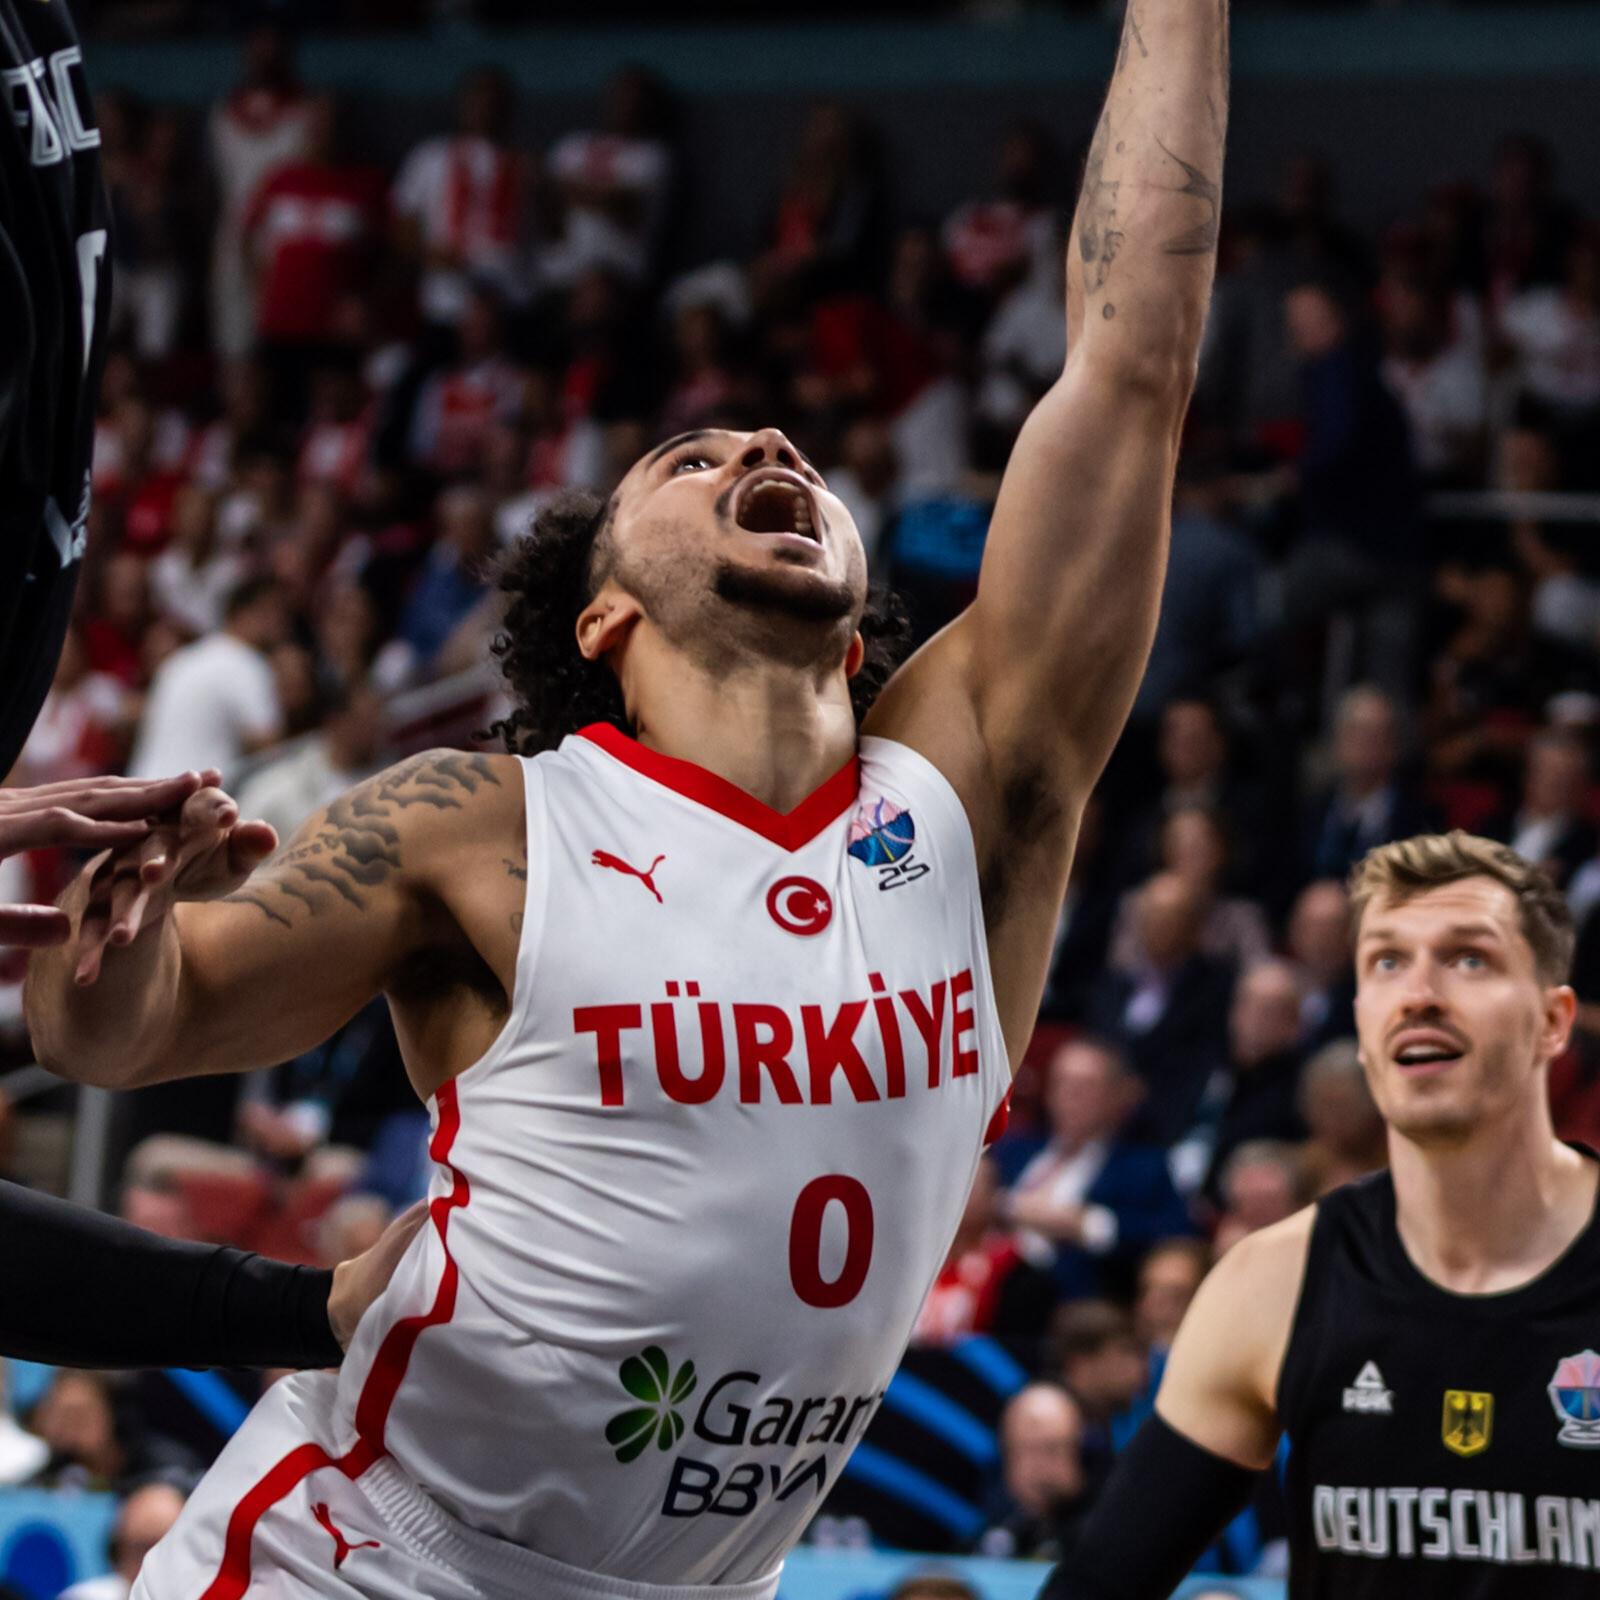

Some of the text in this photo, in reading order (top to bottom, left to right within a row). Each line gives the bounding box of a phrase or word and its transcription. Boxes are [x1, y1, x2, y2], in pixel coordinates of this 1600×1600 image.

[878, 855, 931, 891] 25
[573, 968, 979, 1106] TÜRKİYE
[789, 1173, 874, 1309] 0
